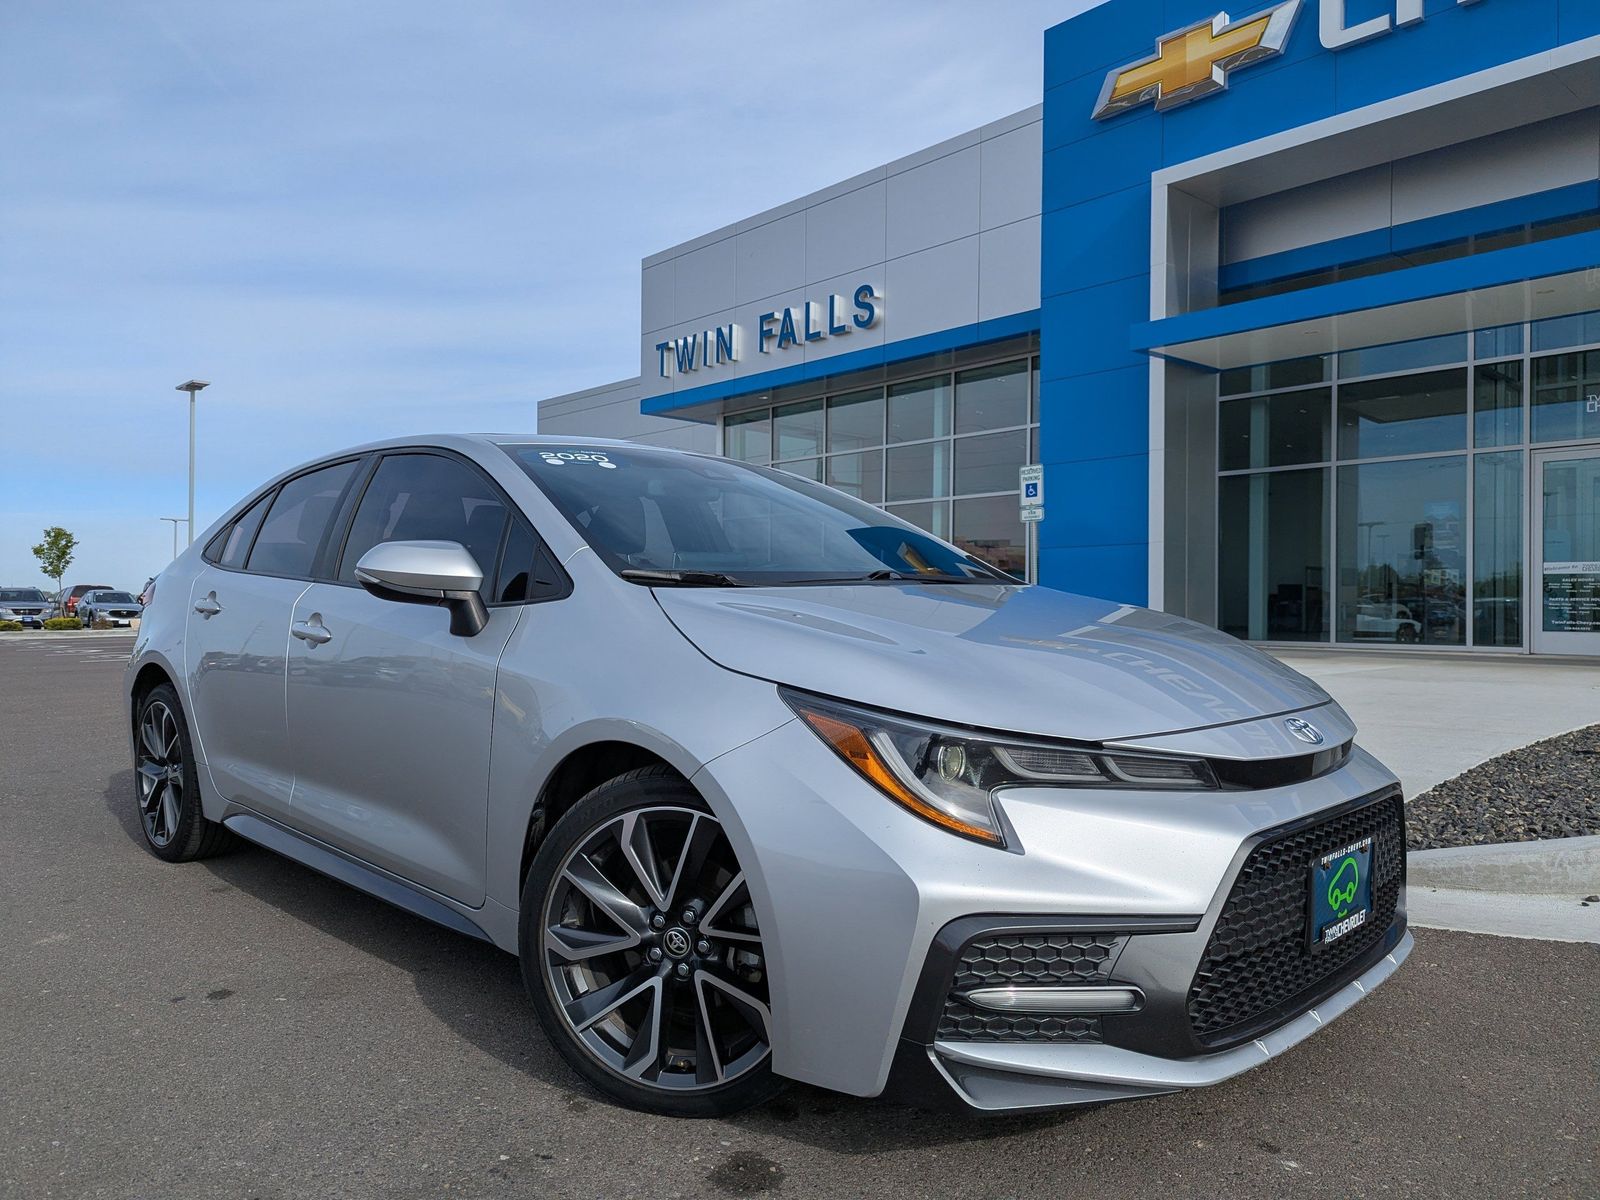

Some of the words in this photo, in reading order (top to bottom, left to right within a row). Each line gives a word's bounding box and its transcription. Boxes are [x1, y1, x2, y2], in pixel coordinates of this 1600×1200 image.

[656, 323, 738, 377] TWIN
[759, 284, 879, 354] FALLS
[539, 452, 609, 462] 2020
[1337, 909, 1366, 936] CHEVROLET
